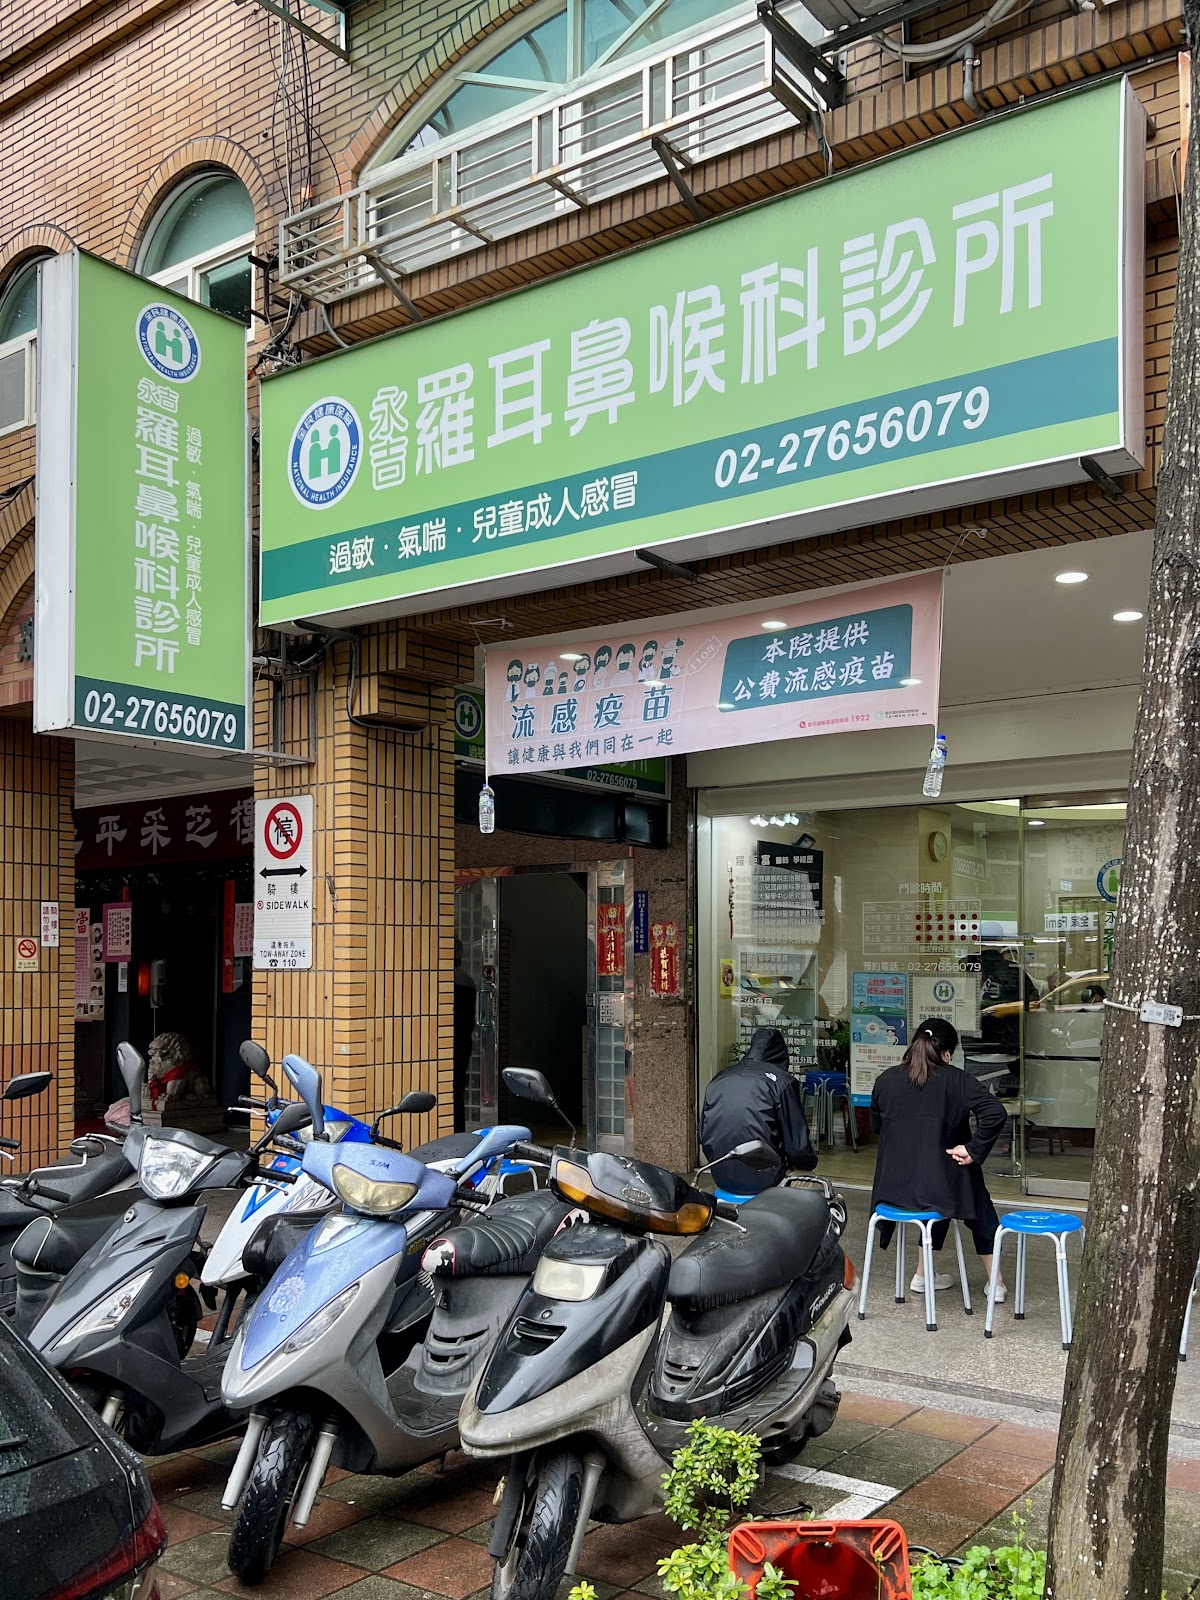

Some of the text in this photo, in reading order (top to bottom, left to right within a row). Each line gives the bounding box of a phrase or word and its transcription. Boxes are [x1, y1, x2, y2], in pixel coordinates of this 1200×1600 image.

[140, 331, 198, 378] NATIONAL HEALTH INSURANCE
[714, 386, 991, 488] 02-27656079
[292, 443, 358, 502] NATIONAL HEALTH INSURANCE
[134, 405, 180, 674] 羅耳鼻喉科診所
[761, 619, 870, 663] 本院提供
[731, 650, 895, 701] 公費流感疫苗
[84, 690, 238, 744] 02-27656079
[510, 685, 674, 742] 流感疫苗
[851, 714, 871, 723] 1922
[507, 728, 674, 766] 讓健康與我們同在一起
[587, 769, 638, 790] 02-27656079
[266, 900, 309, 910] SIDEWALK
[899, 881, 943, 895] 門診時間
[260, 949, 306, 958] TOW-AWAY ZONE
[282, 959, 297, 967] 110
[907, 962, 982, 972] 02-27656079
